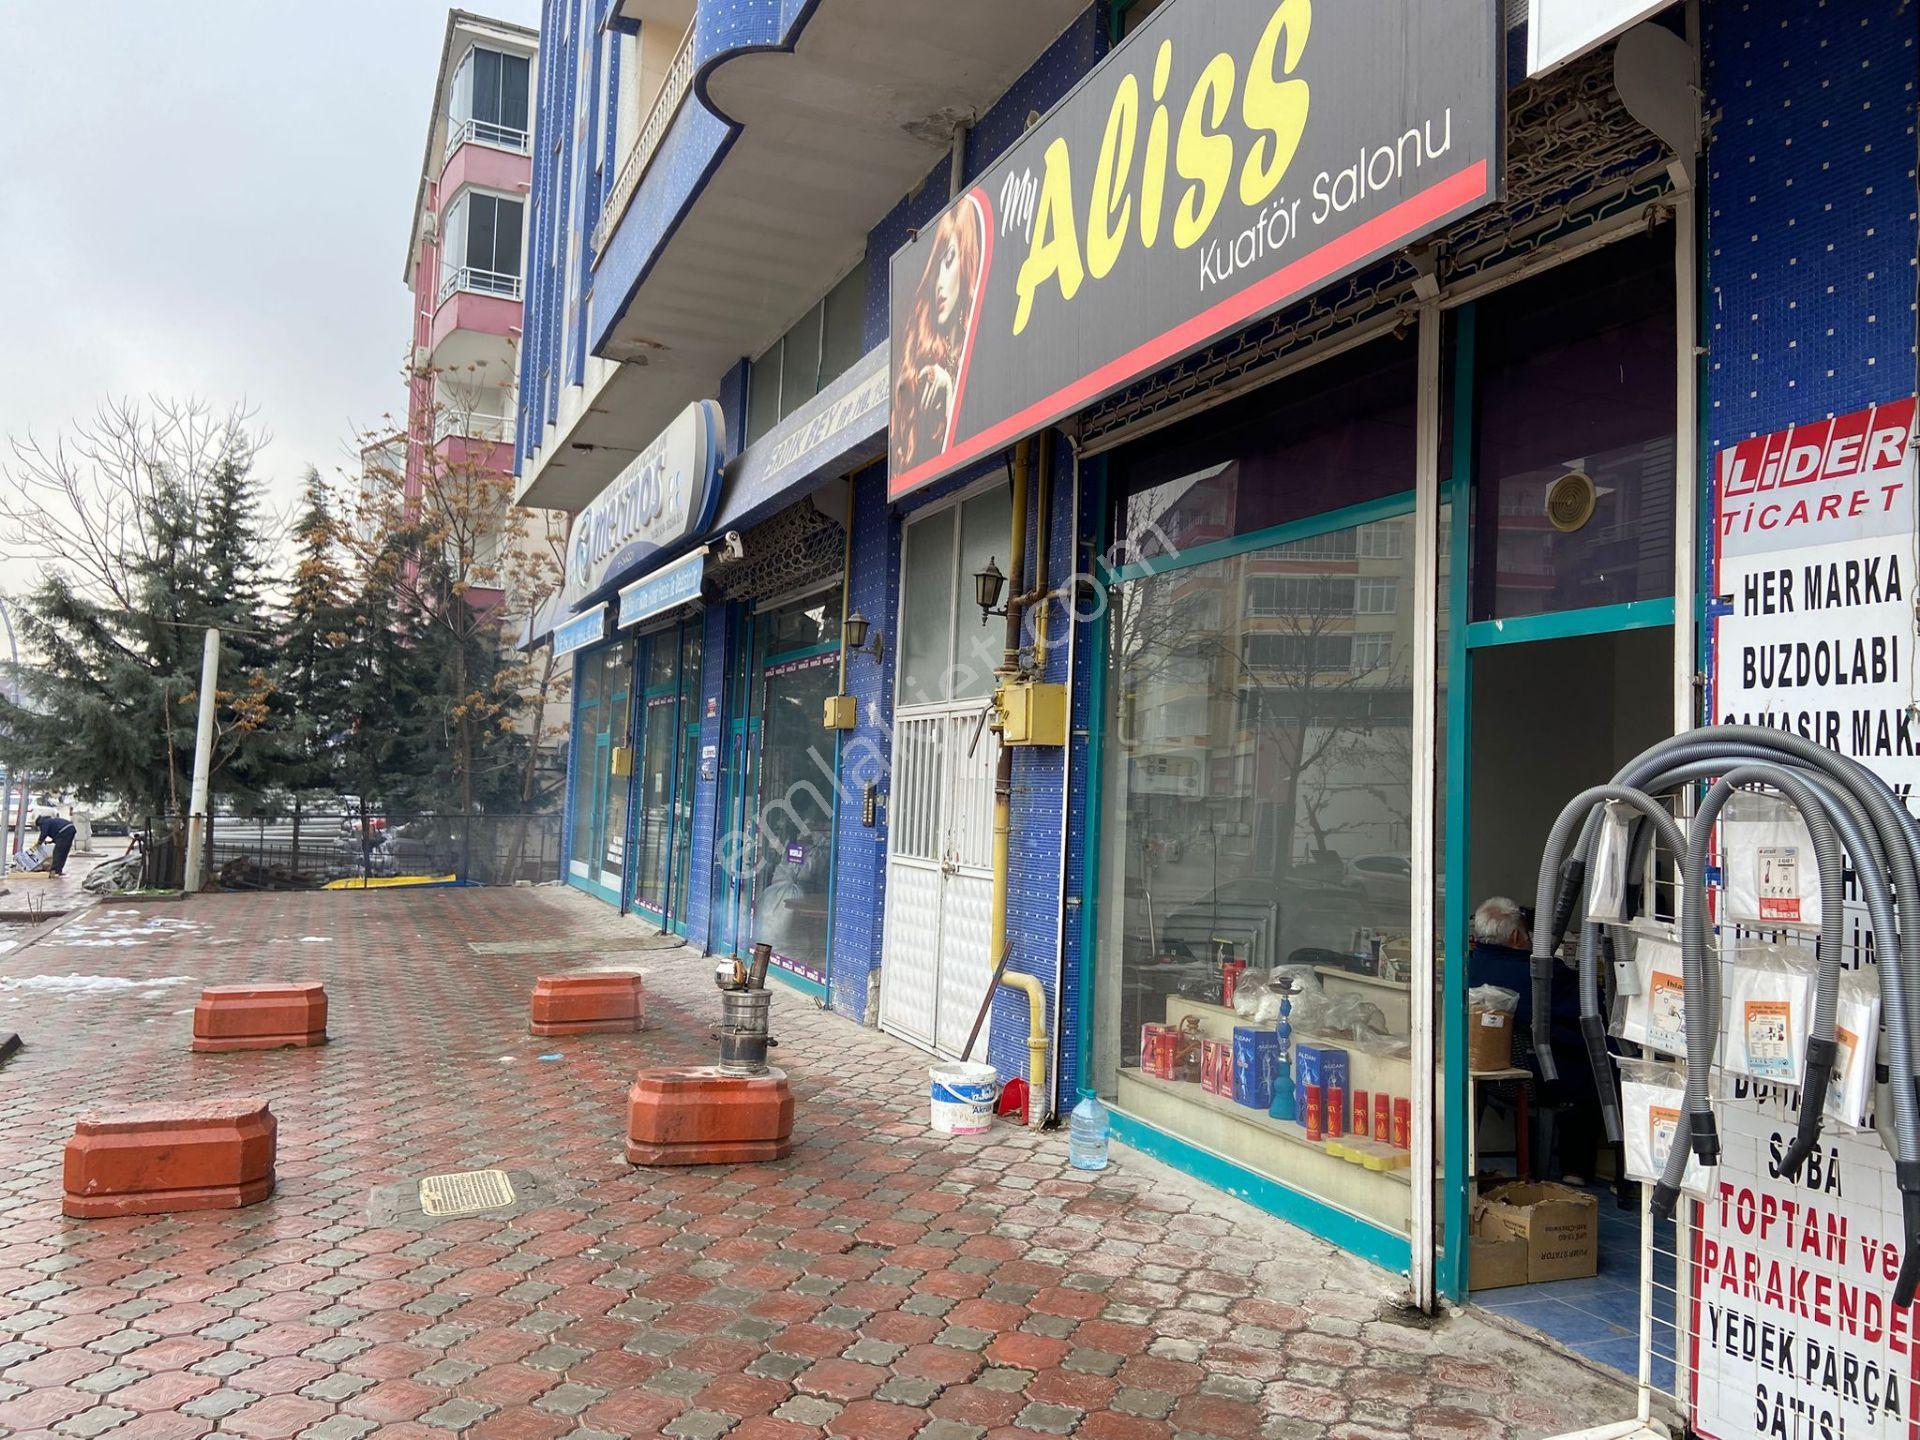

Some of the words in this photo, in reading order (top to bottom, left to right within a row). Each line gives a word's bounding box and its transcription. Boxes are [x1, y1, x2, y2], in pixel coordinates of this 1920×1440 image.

[1199, 199, 1302, 291] Kuaför
[1312, 107, 1452, 225] Salonu
[1744, 568, 1794, 617] HER
[1804, 553, 1903, 611] MARKA
[1742, 635, 1899, 689] BUZDOLABI
[1768, 1132, 1842, 1198] SBA
[1719, 1181, 1848, 1266] TOPTAN
[1861, 1234, 1900, 1282] ve
[1703, 1239, 1910, 1355] PARAKENDE
[1708, 1301, 1795, 1380] YEDEK
[1805, 1337, 1902, 1426] PARÇA
